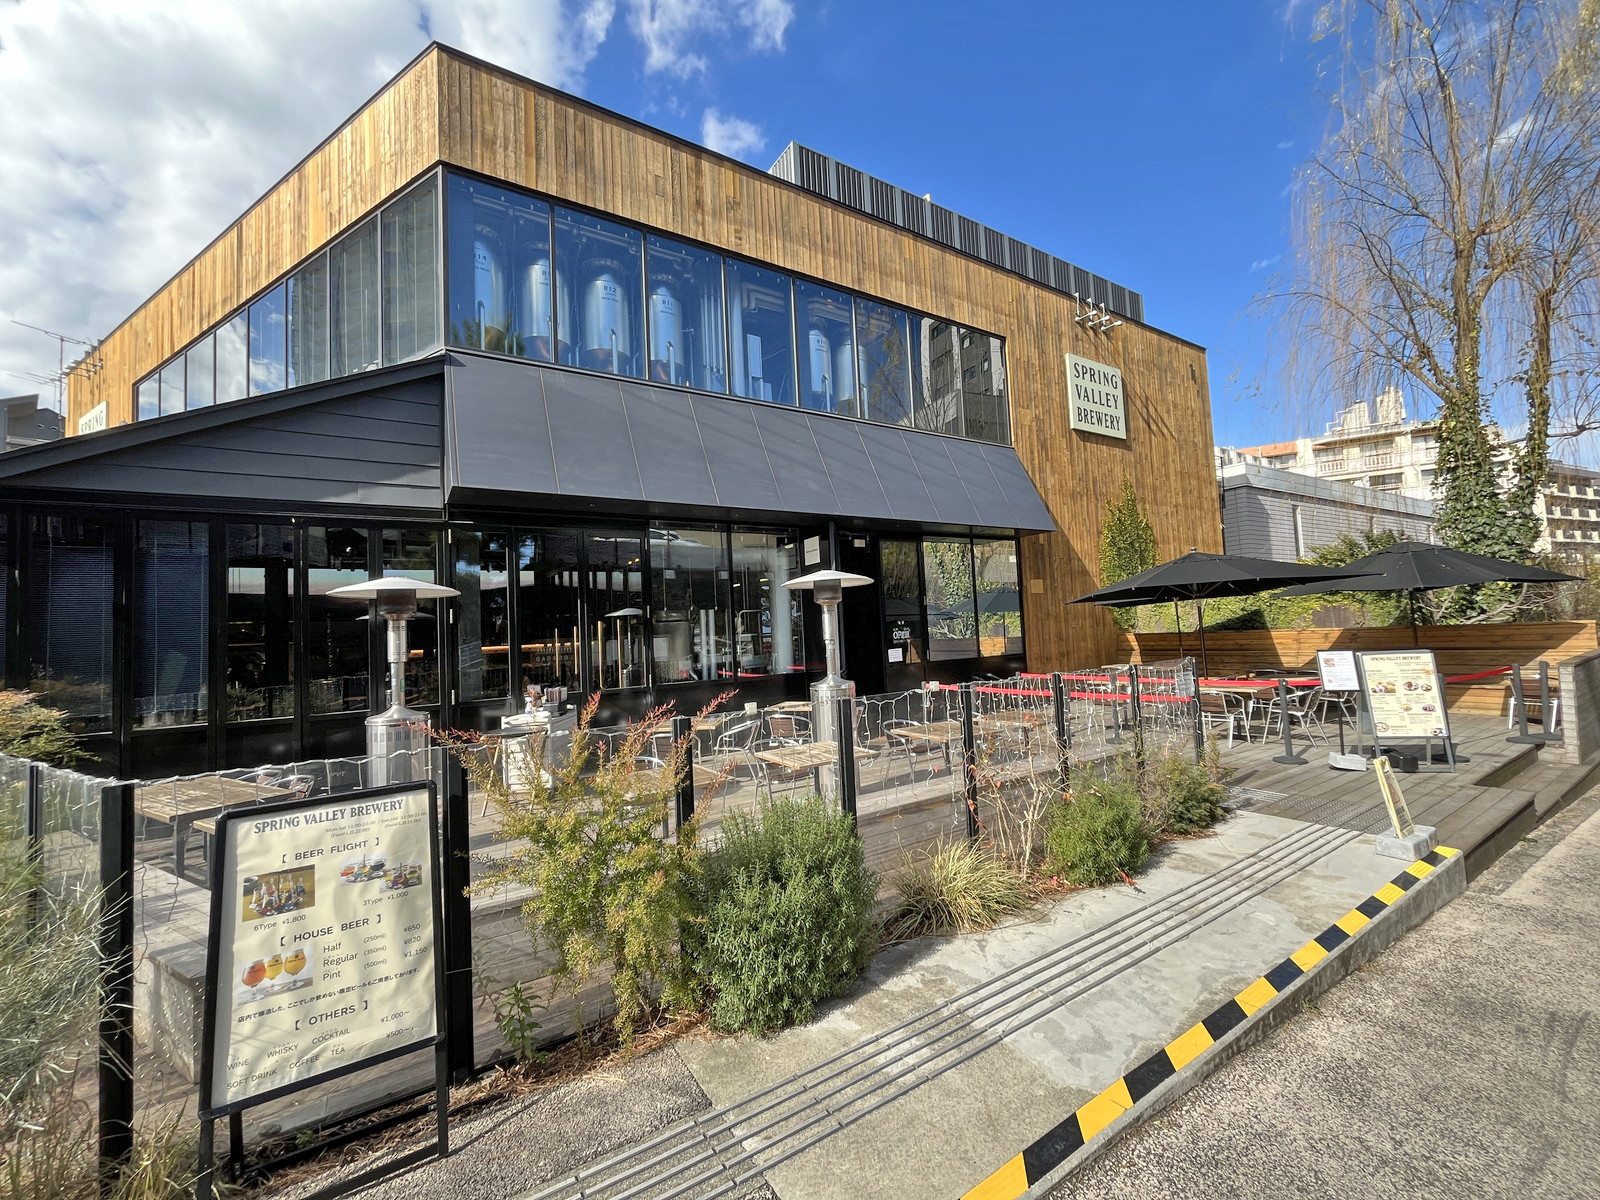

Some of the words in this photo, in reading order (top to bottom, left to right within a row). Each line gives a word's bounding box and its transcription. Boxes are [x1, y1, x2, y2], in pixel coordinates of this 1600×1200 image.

[603, 285, 617, 294] B12
[1073, 362, 1118, 390] SPRING
[1075, 383, 1119, 410] VALLEY
[1077, 406, 1121, 431] BREWERY
[254, 816, 300, 834] SPRING
[304, 808, 347, 825] VALLEY
[350, 799, 404, 818] BREWERY
[294, 848, 324, 860] BEER
[330, 840, 368, 854] FLIGHT
[362, 897, 383, 906] 3Type
[387, 890, 409, 900] ¥1,000
[253, 921, 278, 932] 6Type
[282, 914, 307, 925] ¥1,800
[293, 926, 334, 943] HOUSE
[341, 917, 370, 931] BEER
[323, 942, 342, 953] Half
[363, 933, 387, 944] (250ml)
[403, 923, 421, 933] ¥650
[323, 952, 358, 968] Regular
[363, 945, 387, 957] (350ml)
[403, 935, 421, 945] ¥820
[322, 970, 342, 982] Pint
[363, 958, 388, 970] (500ml)
[403, 946, 428, 958] ¥1,150
[308, 1004, 356, 1025] OTHERS
[226, 1058, 250, 1071] WINE
[266, 1043, 299, 1058] WHISKY
[312, 1028, 351, 1045] COCKTAIL
[226, 1076, 249, 1090] SOFT
[251, 1068, 278, 1082] DRINK
[289, 1054, 320, 1070] COFFEE
[331, 1047, 346, 1056] TEA
